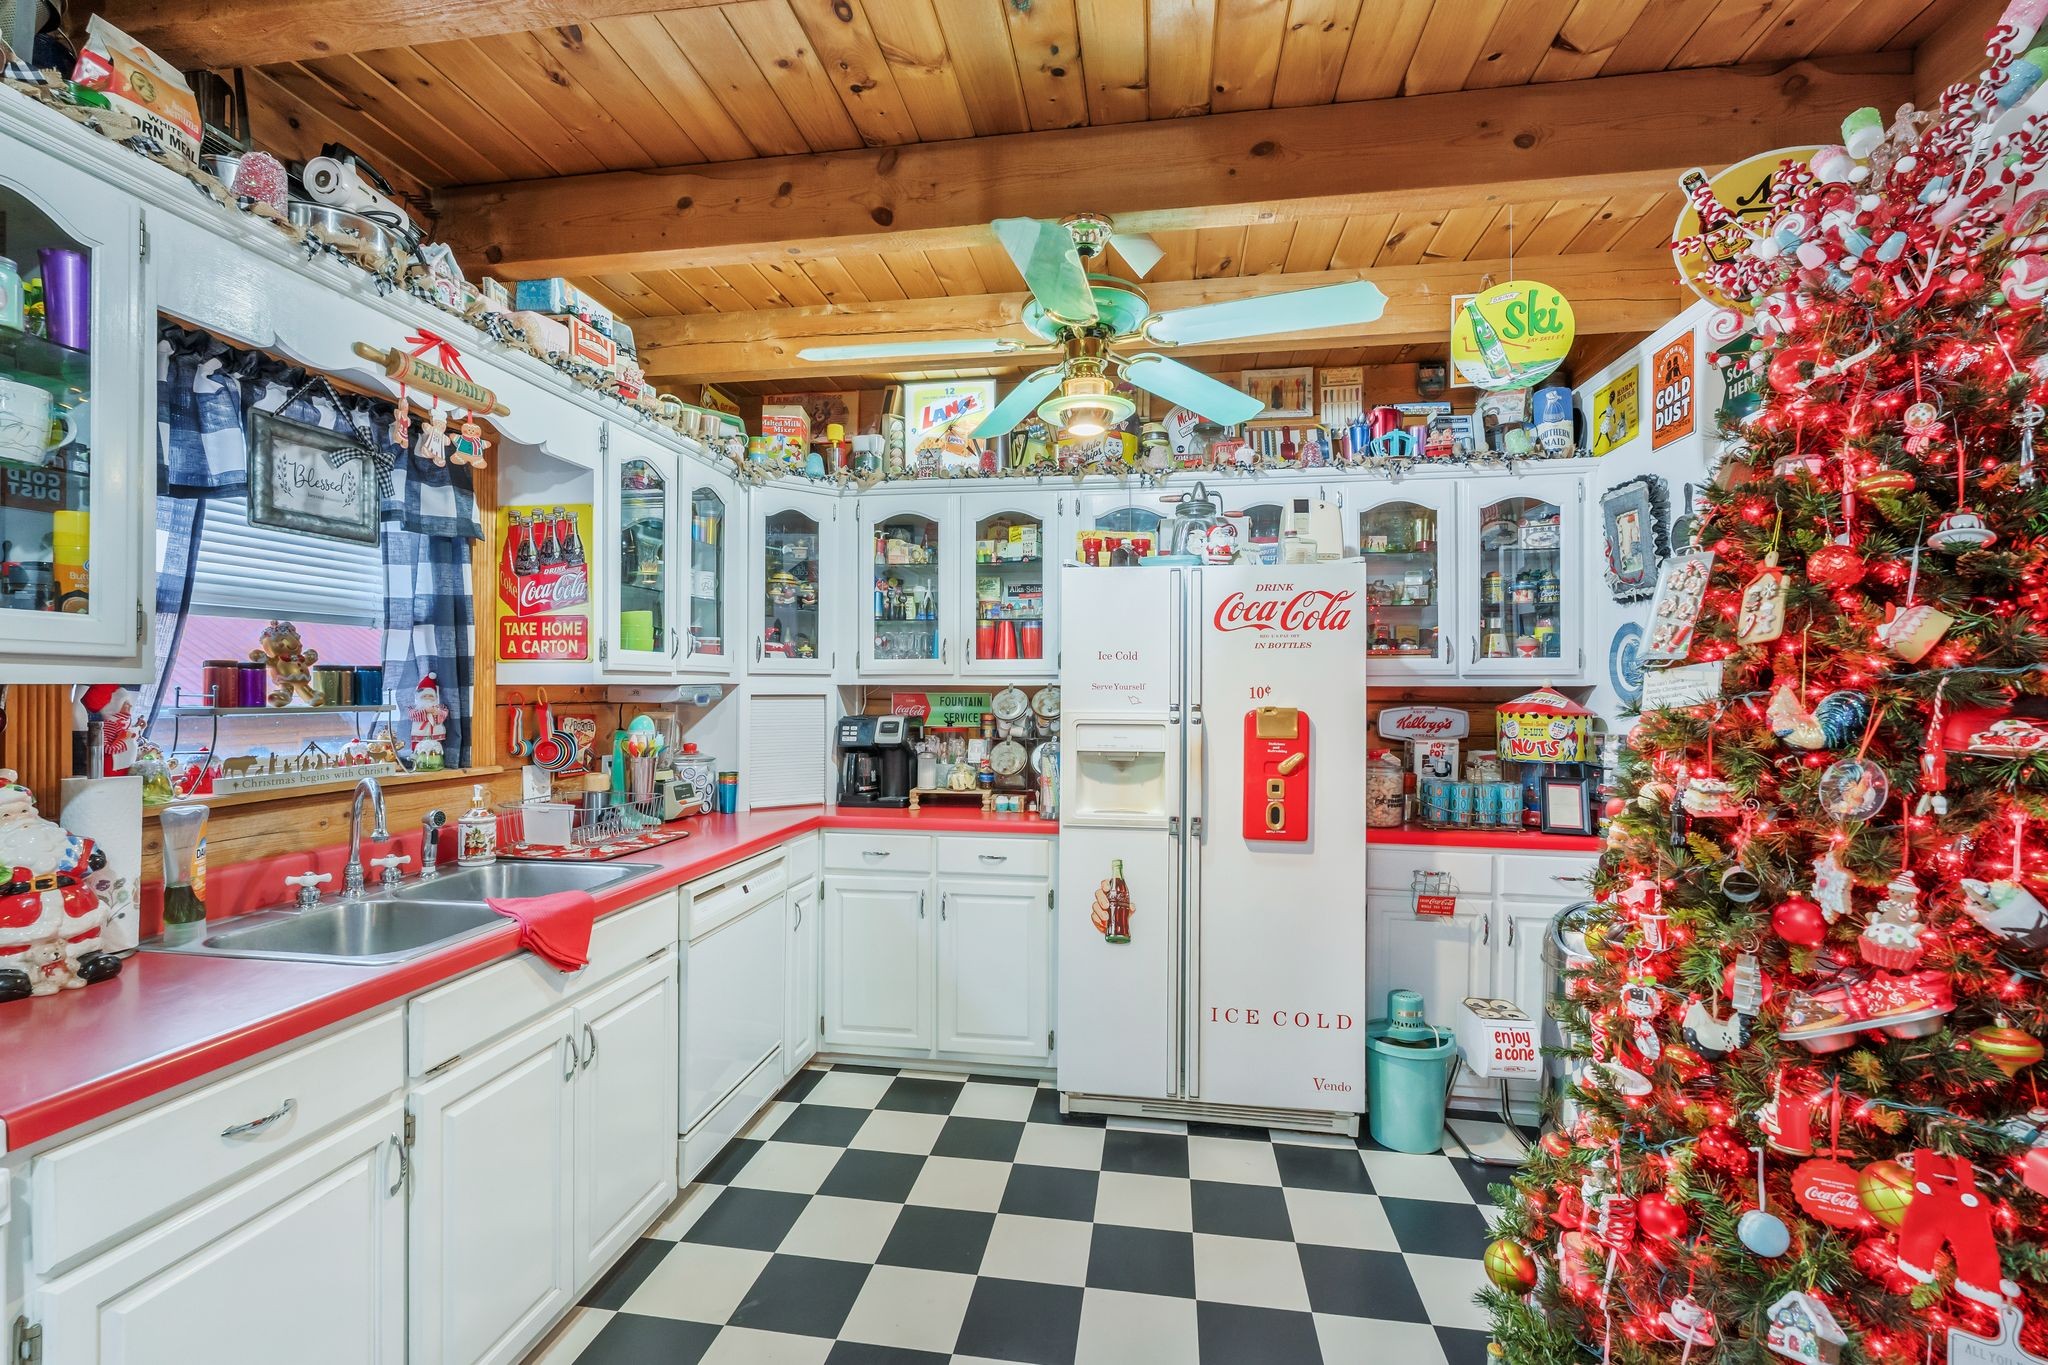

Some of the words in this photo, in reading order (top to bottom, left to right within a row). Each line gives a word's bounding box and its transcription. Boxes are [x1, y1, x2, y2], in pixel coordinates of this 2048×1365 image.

[147, 112, 183, 138] WHITE
[131, 115, 163, 141] ORN
[169, 133, 198, 165] MEAL
[1502, 288, 1564, 339] Ski
[414, 361, 453, 389] FRESH
[455, 378, 486, 402] DAILY
[1726, 363, 1751, 383] SOL
[1656, 376, 1691, 410] GOLD
[922, 395, 977, 430] LANCE
[1655, 396, 1690, 432] DUST
[1540, 428, 1570, 441] OUTHERN
[1544, 437, 1566, 448] MAID
[288, 461, 347, 495] Blessed
[500, 571, 518, 599] Coke
[1255, 583, 1294, 592] DRINK
[504, 622, 537, 636] TAKE
[541, 621, 583, 636] HOME
[507, 639, 517, 654] A
[521, 639, 578, 655] CARTON
[1098, 650, 1113, 660] Ice
[1115, 650, 1138, 660] Cold
[1091, 682, 1113, 690] Serve
[1114, 682, 1146, 690] Yourself
[1249, 685, 1271, 699] 10¢
[939, 696, 983, 706] FOUNTAIN
[943, 712, 978, 722] SERVICE
[1396, 714, 1453, 733] Kellogg's
[1429, 749, 1446, 757] POT
[1510, 739, 1561, 757] NUTS
[242, 776, 296, 790] Christmas
[300, 772, 330, 784] begins
[334, 770, 354, 779] with
[357, 766, 383, 776] Christ
[1211, 1007, 1260, 1025] ICE
[1273, 1010, 1352, 1030] COLD
[1494, 1027, 1531, 1048] enjoy
[1495, 1047, 1502, 1060] a
[1504, 1048, 1535, 1061] cone
[1313, 1077, 1352, 1092] Vendo
[1965, 1344, 1986, 1361] ALL
